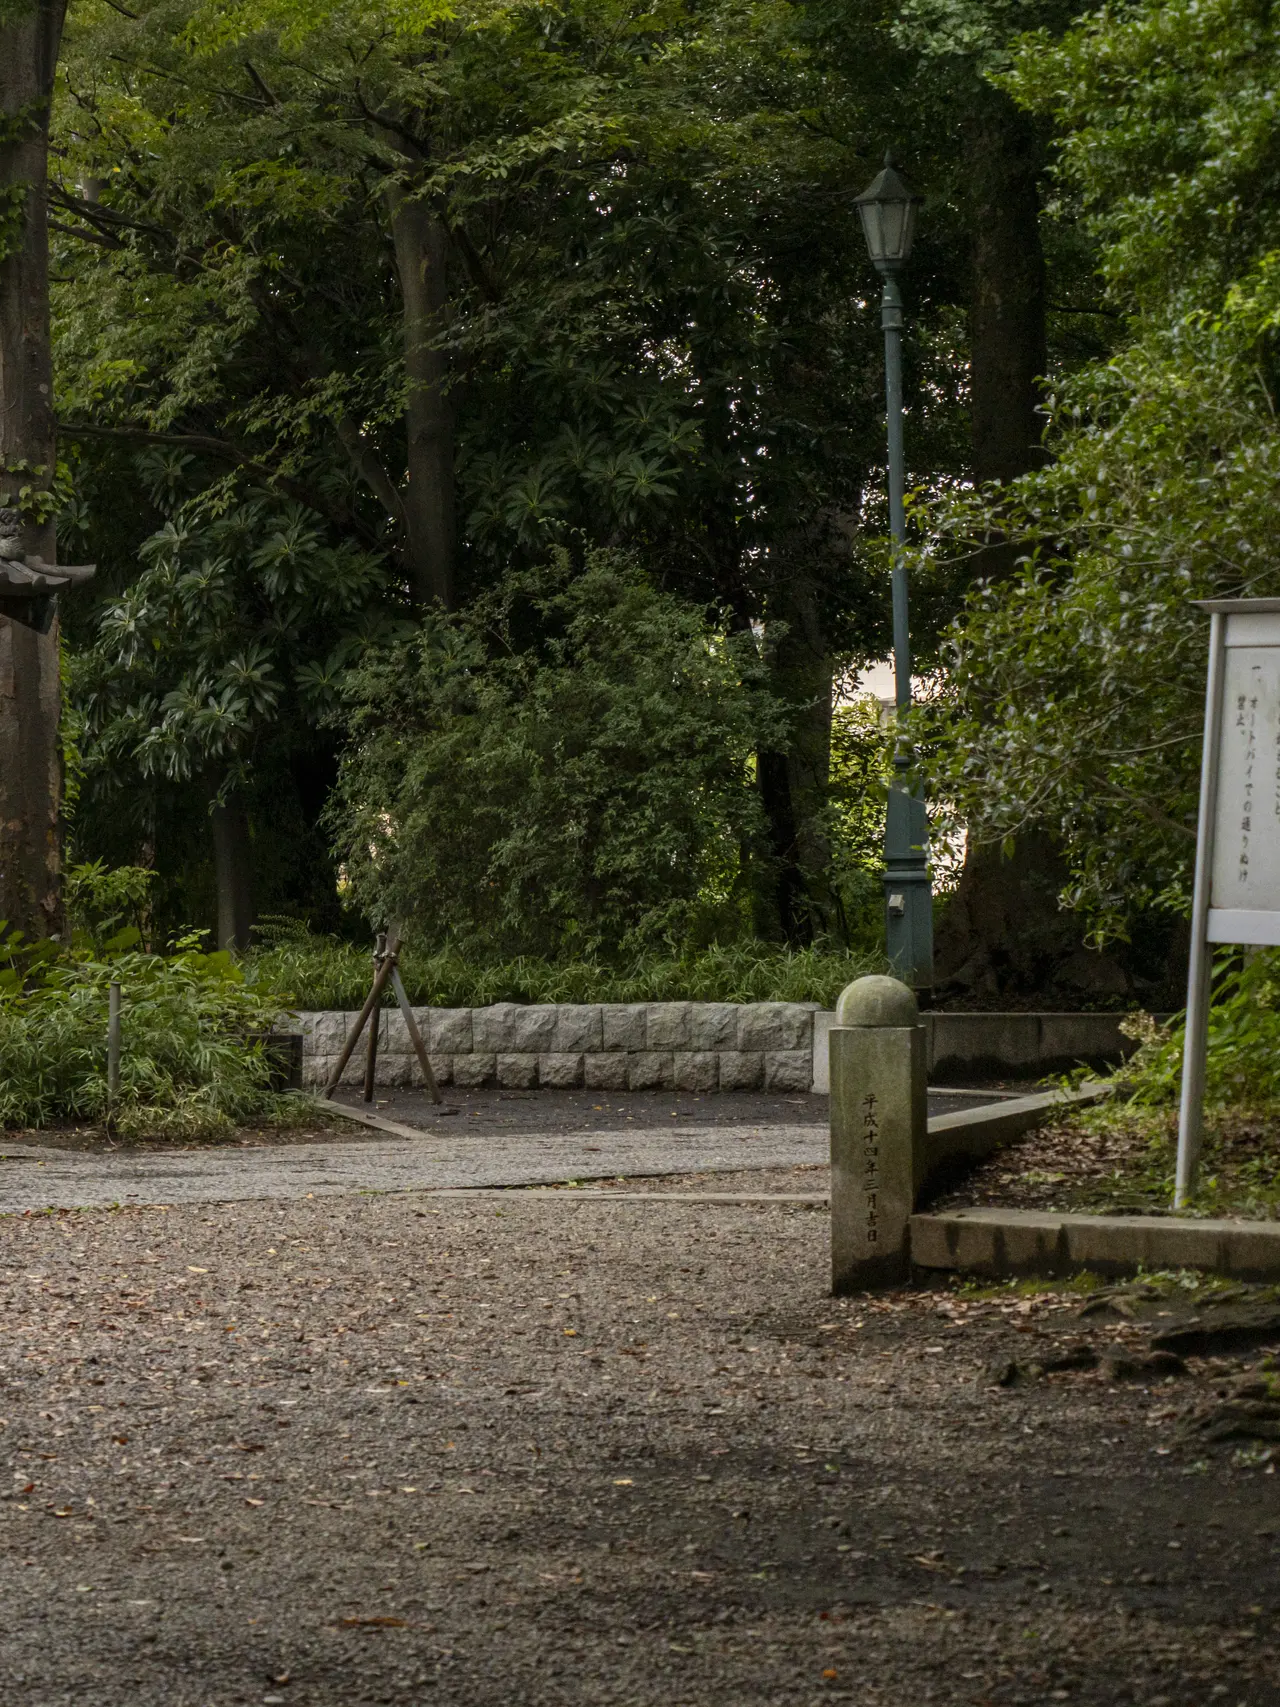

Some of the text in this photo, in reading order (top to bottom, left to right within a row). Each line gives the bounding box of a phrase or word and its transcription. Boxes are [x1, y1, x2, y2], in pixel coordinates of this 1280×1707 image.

[862, 1093, 880, 1242] 平成十四年三月吉日
